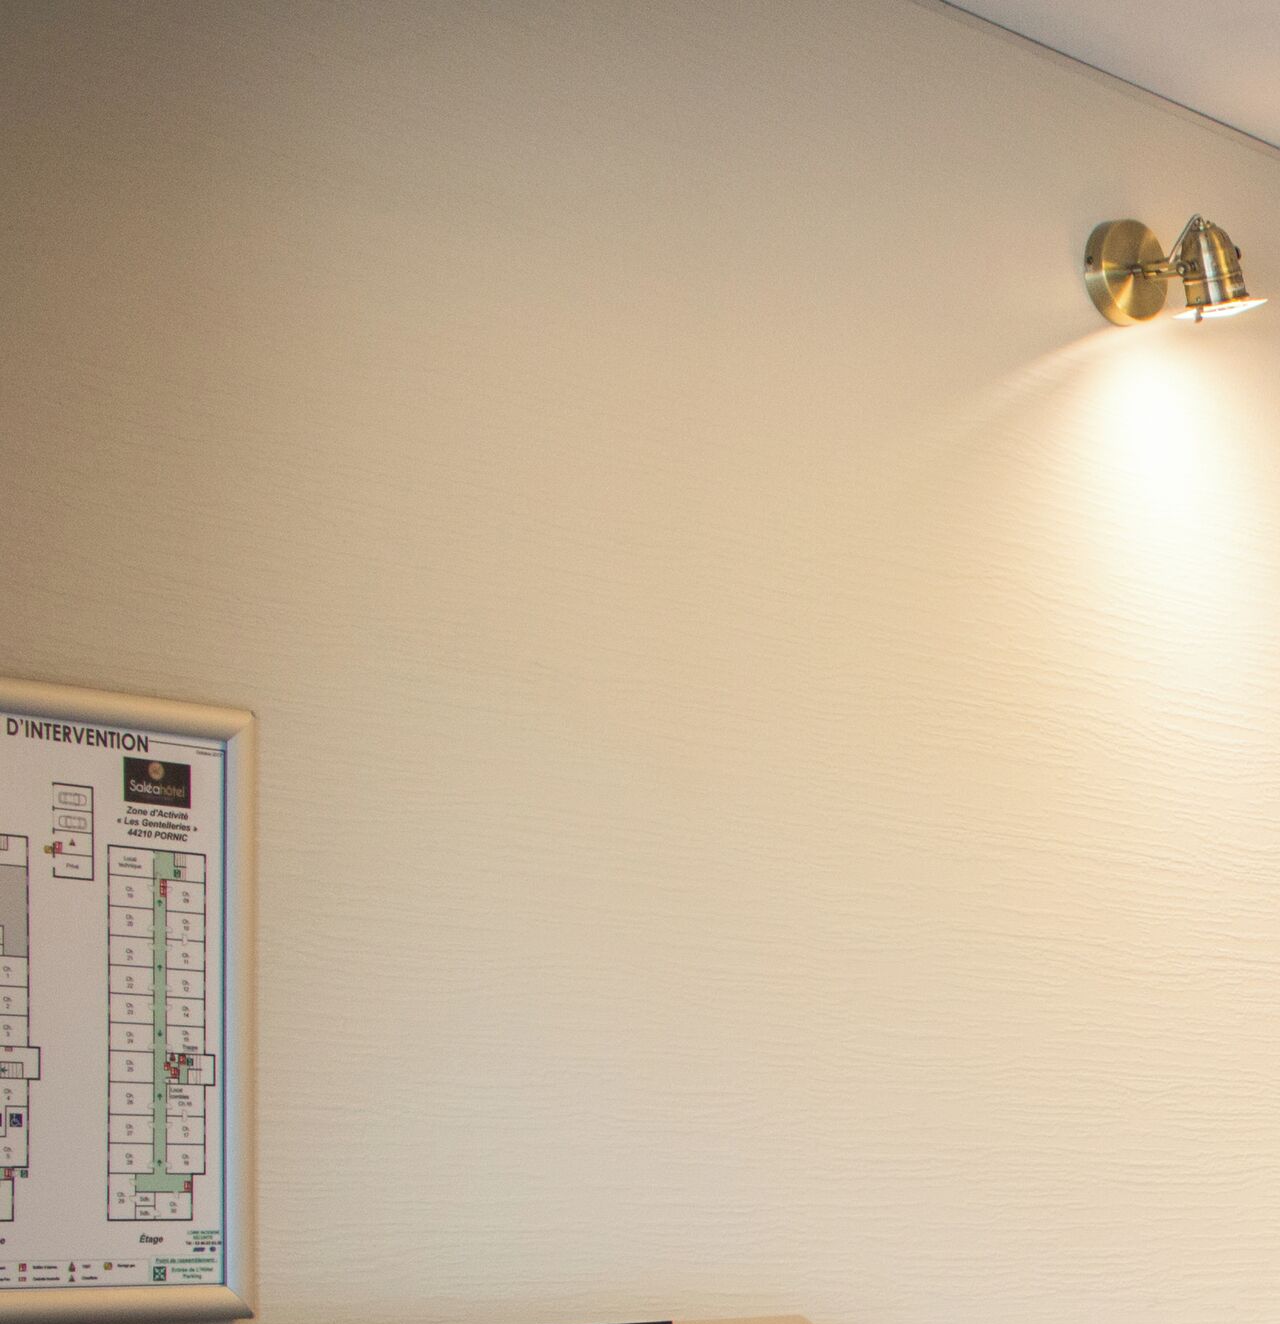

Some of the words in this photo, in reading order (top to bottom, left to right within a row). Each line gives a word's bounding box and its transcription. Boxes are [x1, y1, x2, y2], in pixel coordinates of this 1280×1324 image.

[6, 717, 149, 753] D'INTERVENTION
[126, 805, 148, 816] Zone
[124, 816, 139, 826] Les
[154, 831, 189, 843] PORNIC
[139, 1232, 164, 1246] Étage
